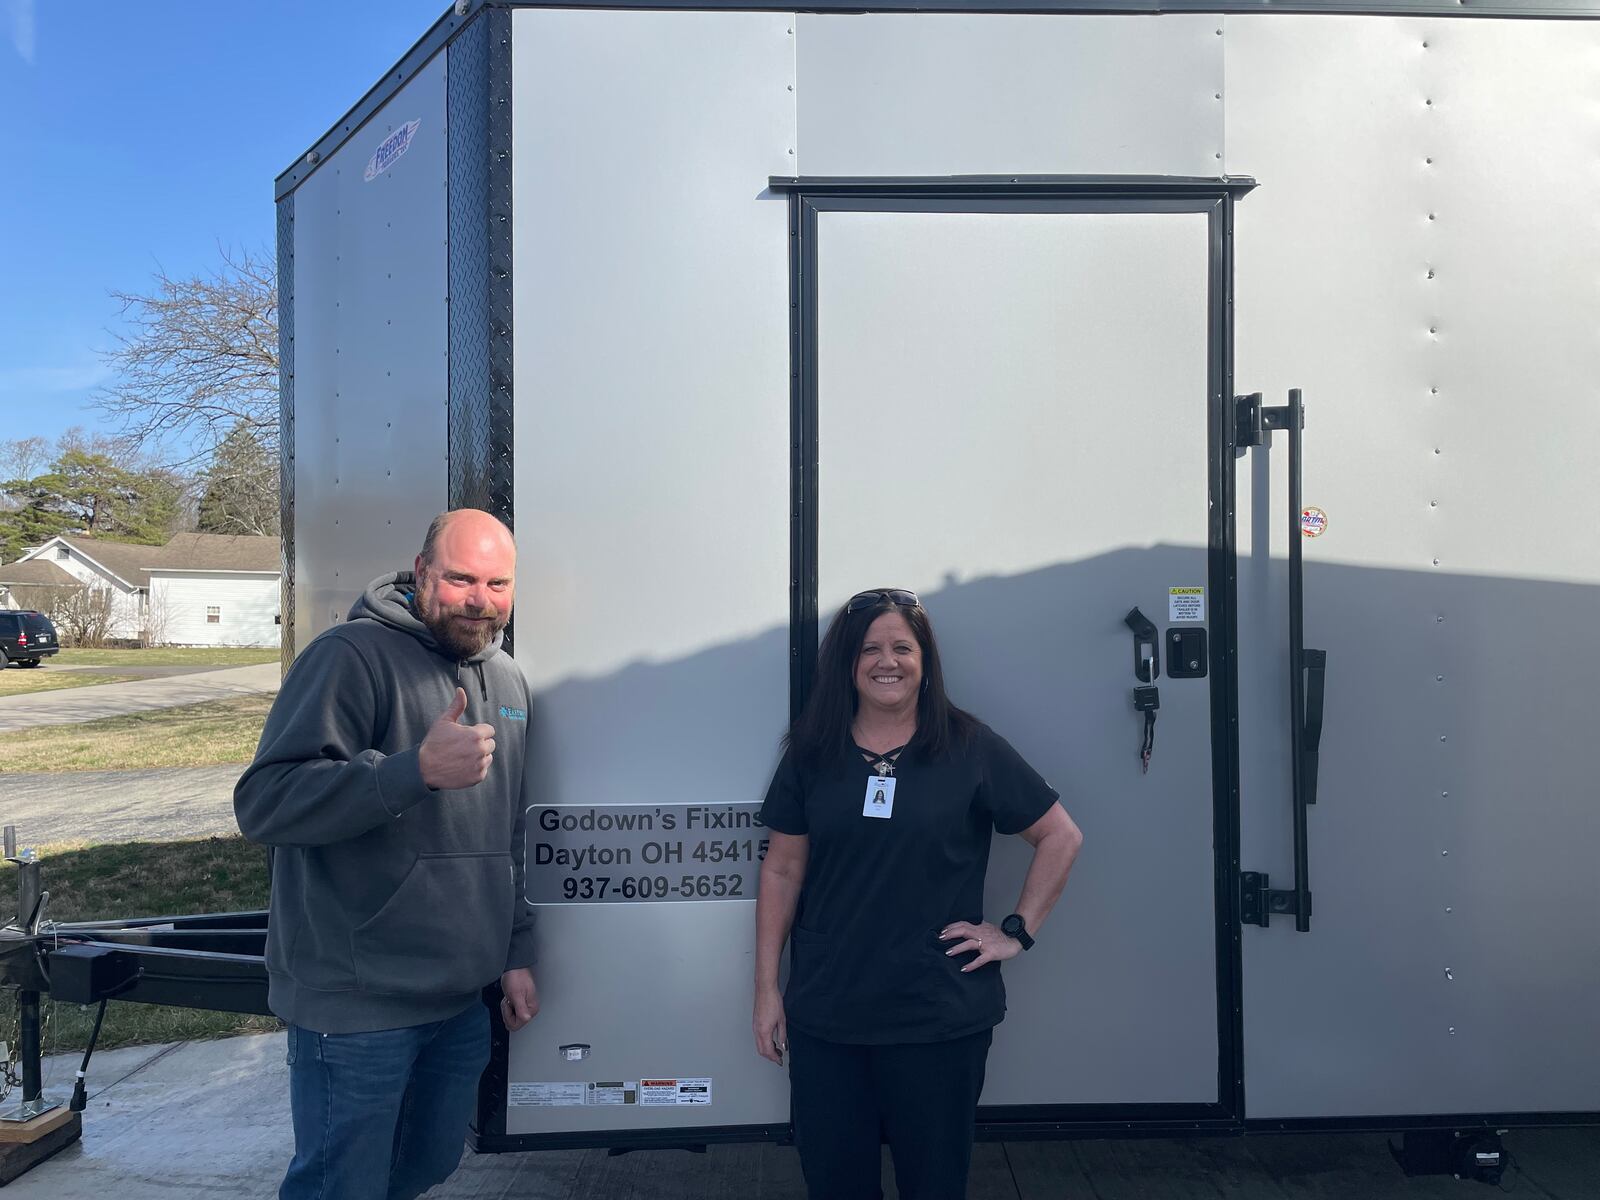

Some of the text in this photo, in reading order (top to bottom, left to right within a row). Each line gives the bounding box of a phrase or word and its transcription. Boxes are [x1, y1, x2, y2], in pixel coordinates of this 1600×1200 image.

[539, 807, 764, 831] Godown's Fixins
[535, 839, 770, 870] Dayton OH 45415
[563, 874, 743, 899] 937-609-5652
